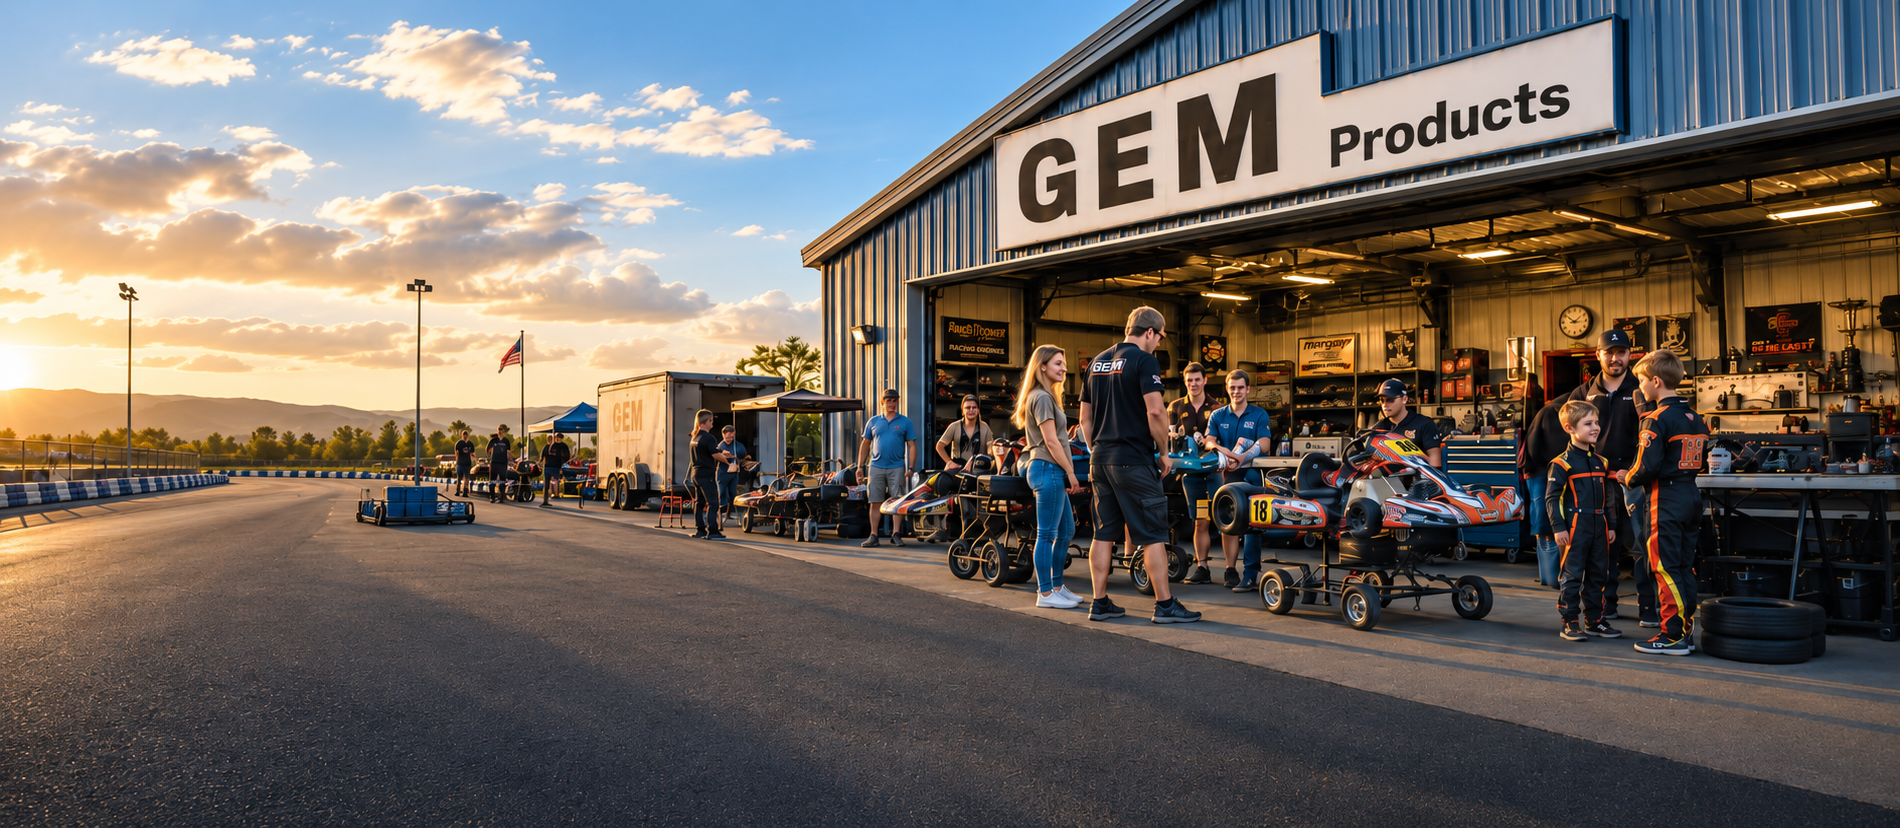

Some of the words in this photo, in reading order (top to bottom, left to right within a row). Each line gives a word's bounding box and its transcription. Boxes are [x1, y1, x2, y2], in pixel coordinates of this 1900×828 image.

[1018, 73, 1279, 223] GEM
[1330, 83, 1570, 168] Products
[1092, 360, 1124, 373] GEM
[613, 399, 643, 433] GEM
[1253, 499, 1268, 522] 18
